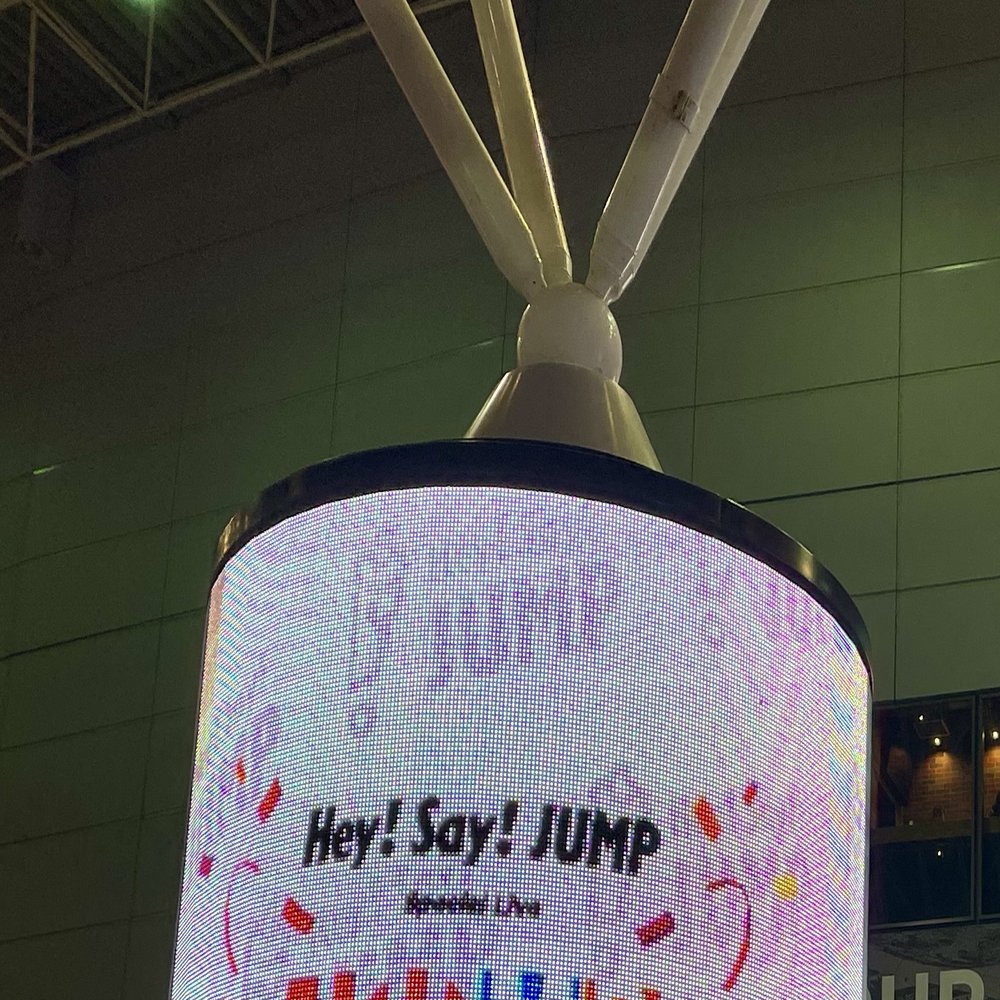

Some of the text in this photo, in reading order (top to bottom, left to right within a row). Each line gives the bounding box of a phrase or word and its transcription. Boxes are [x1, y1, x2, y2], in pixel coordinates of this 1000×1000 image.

[301, 795, 662, 875] Hey! Say! JUMP
